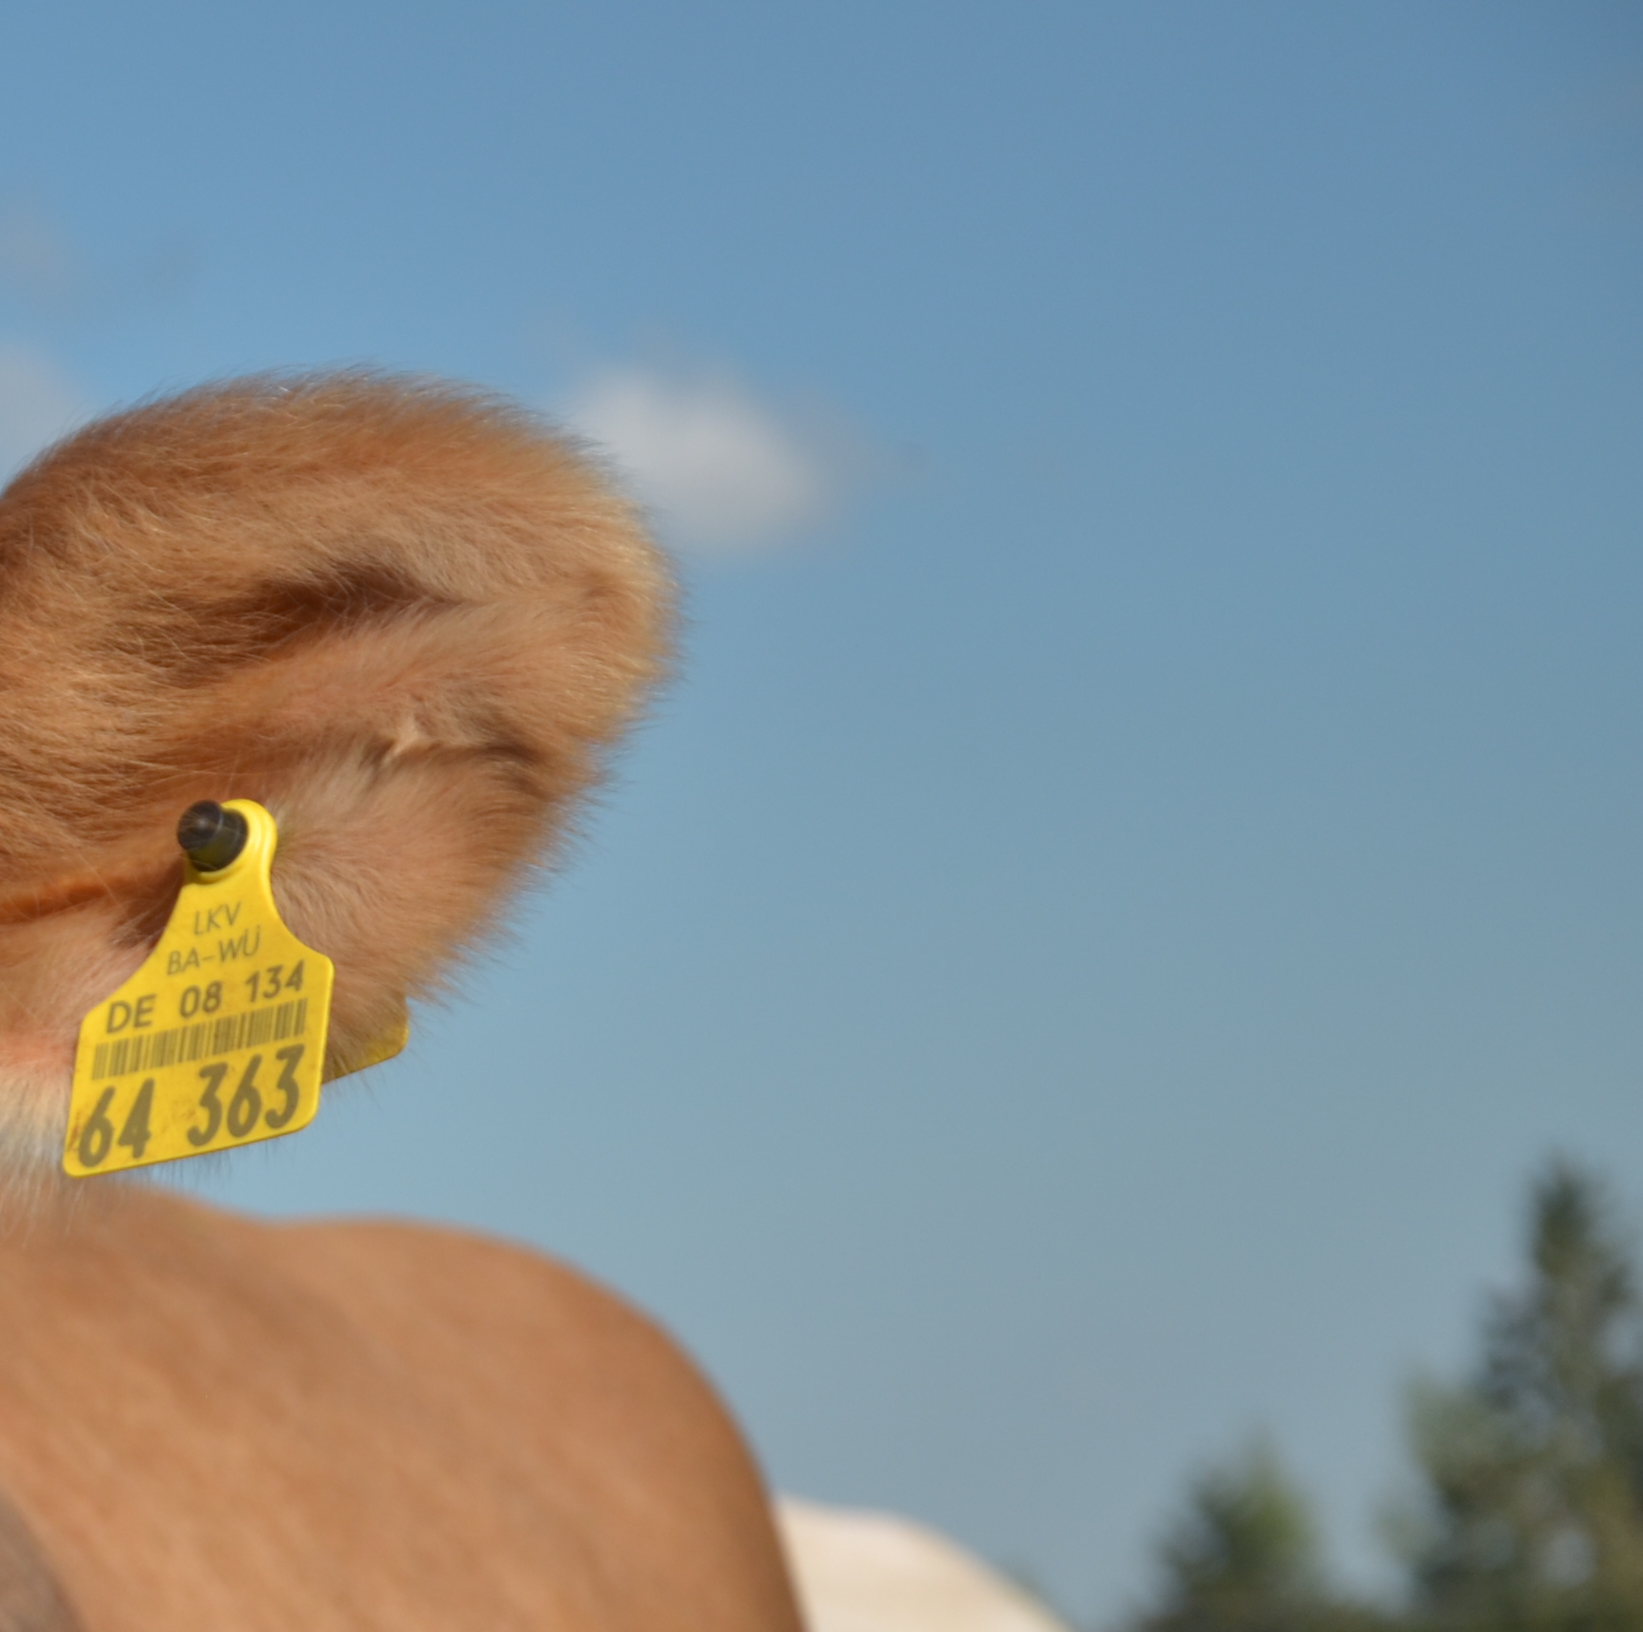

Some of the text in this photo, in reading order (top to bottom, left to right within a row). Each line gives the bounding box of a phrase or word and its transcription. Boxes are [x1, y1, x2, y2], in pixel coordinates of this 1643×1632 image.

[193, 901, 242, 937] LKV
[106, 959, 306, 1034] DE 08 134
[78, 1043, 306, 1168] 64 363
